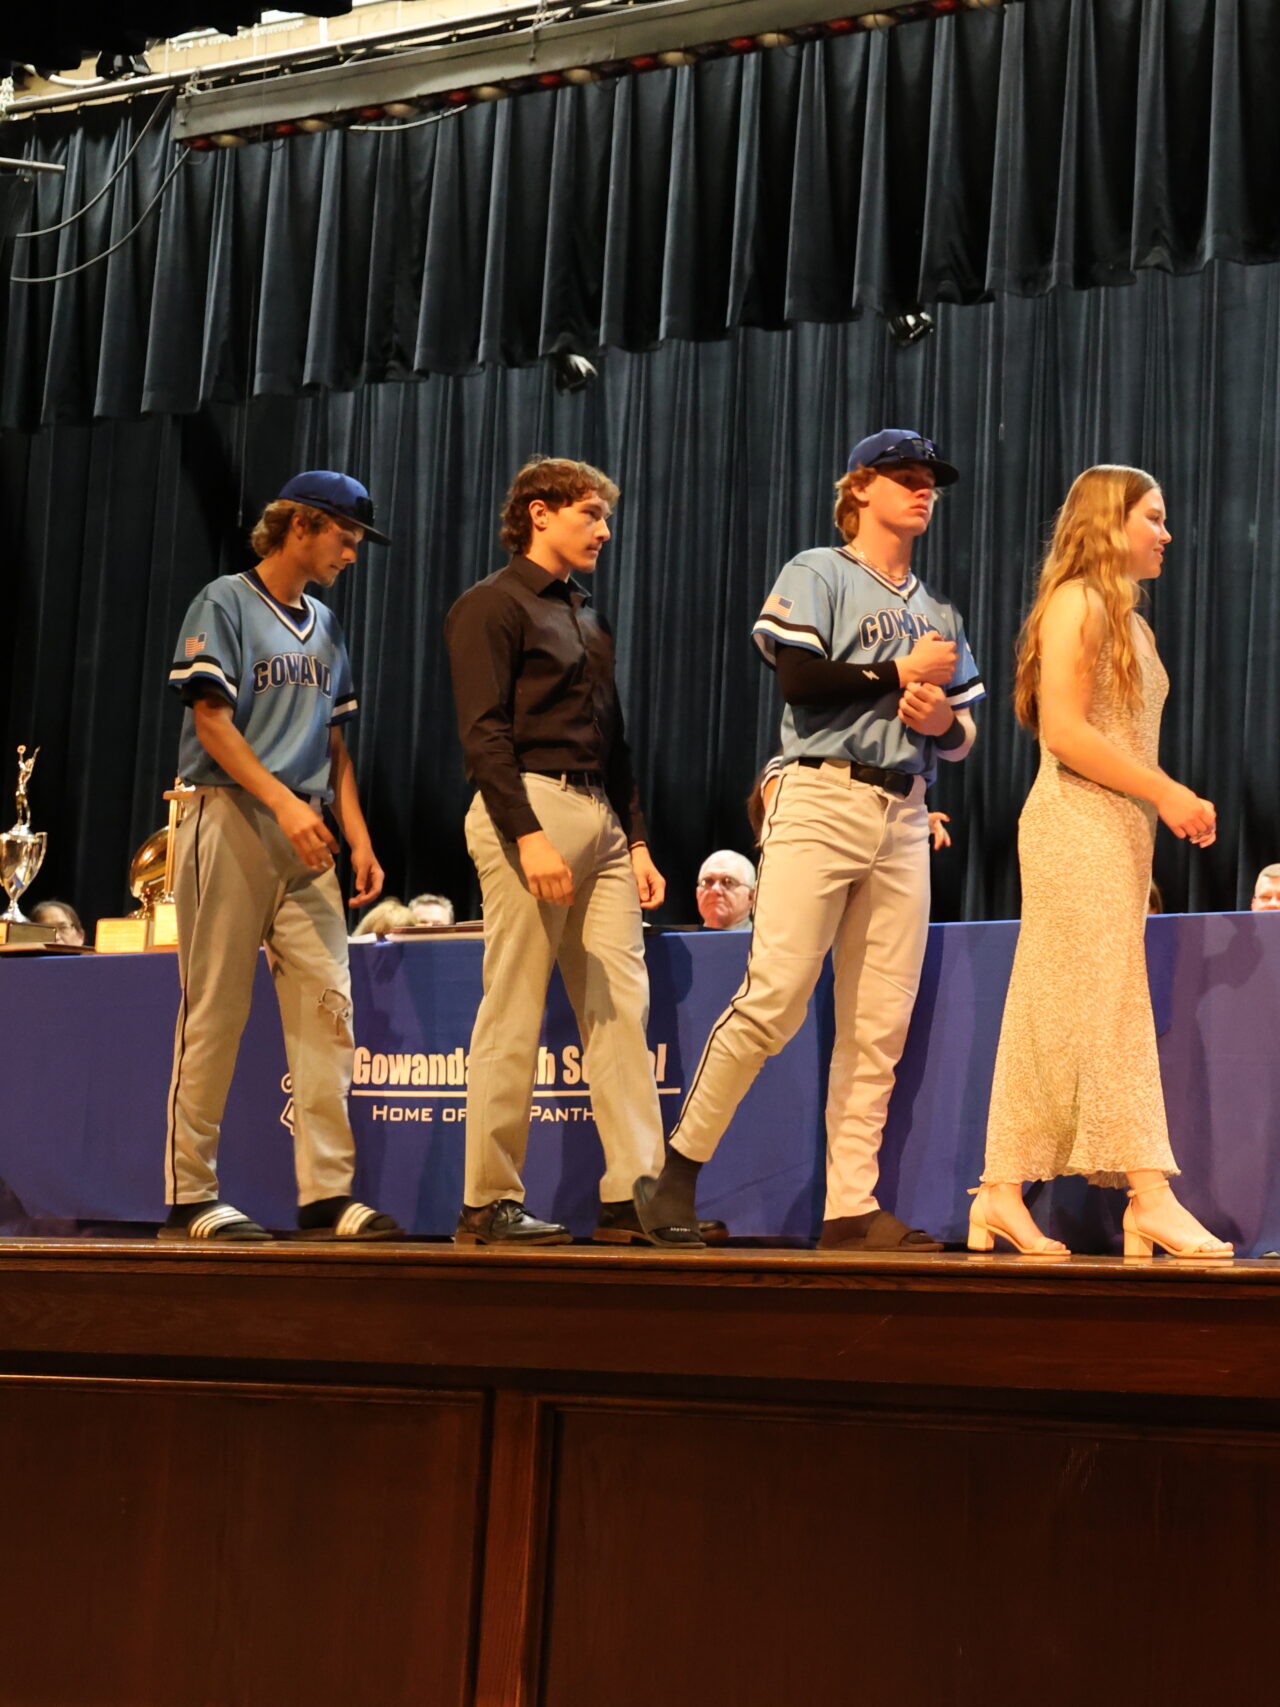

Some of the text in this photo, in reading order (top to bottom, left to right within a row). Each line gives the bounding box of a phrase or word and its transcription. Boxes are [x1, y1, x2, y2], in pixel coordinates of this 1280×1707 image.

[859, 608, 932, 651] GOWAN
[252, 653, 332, 698] GOWAND
[372, 1104, 433, 1122] HOME
[529, 1105, 596, 1123] PANTH
